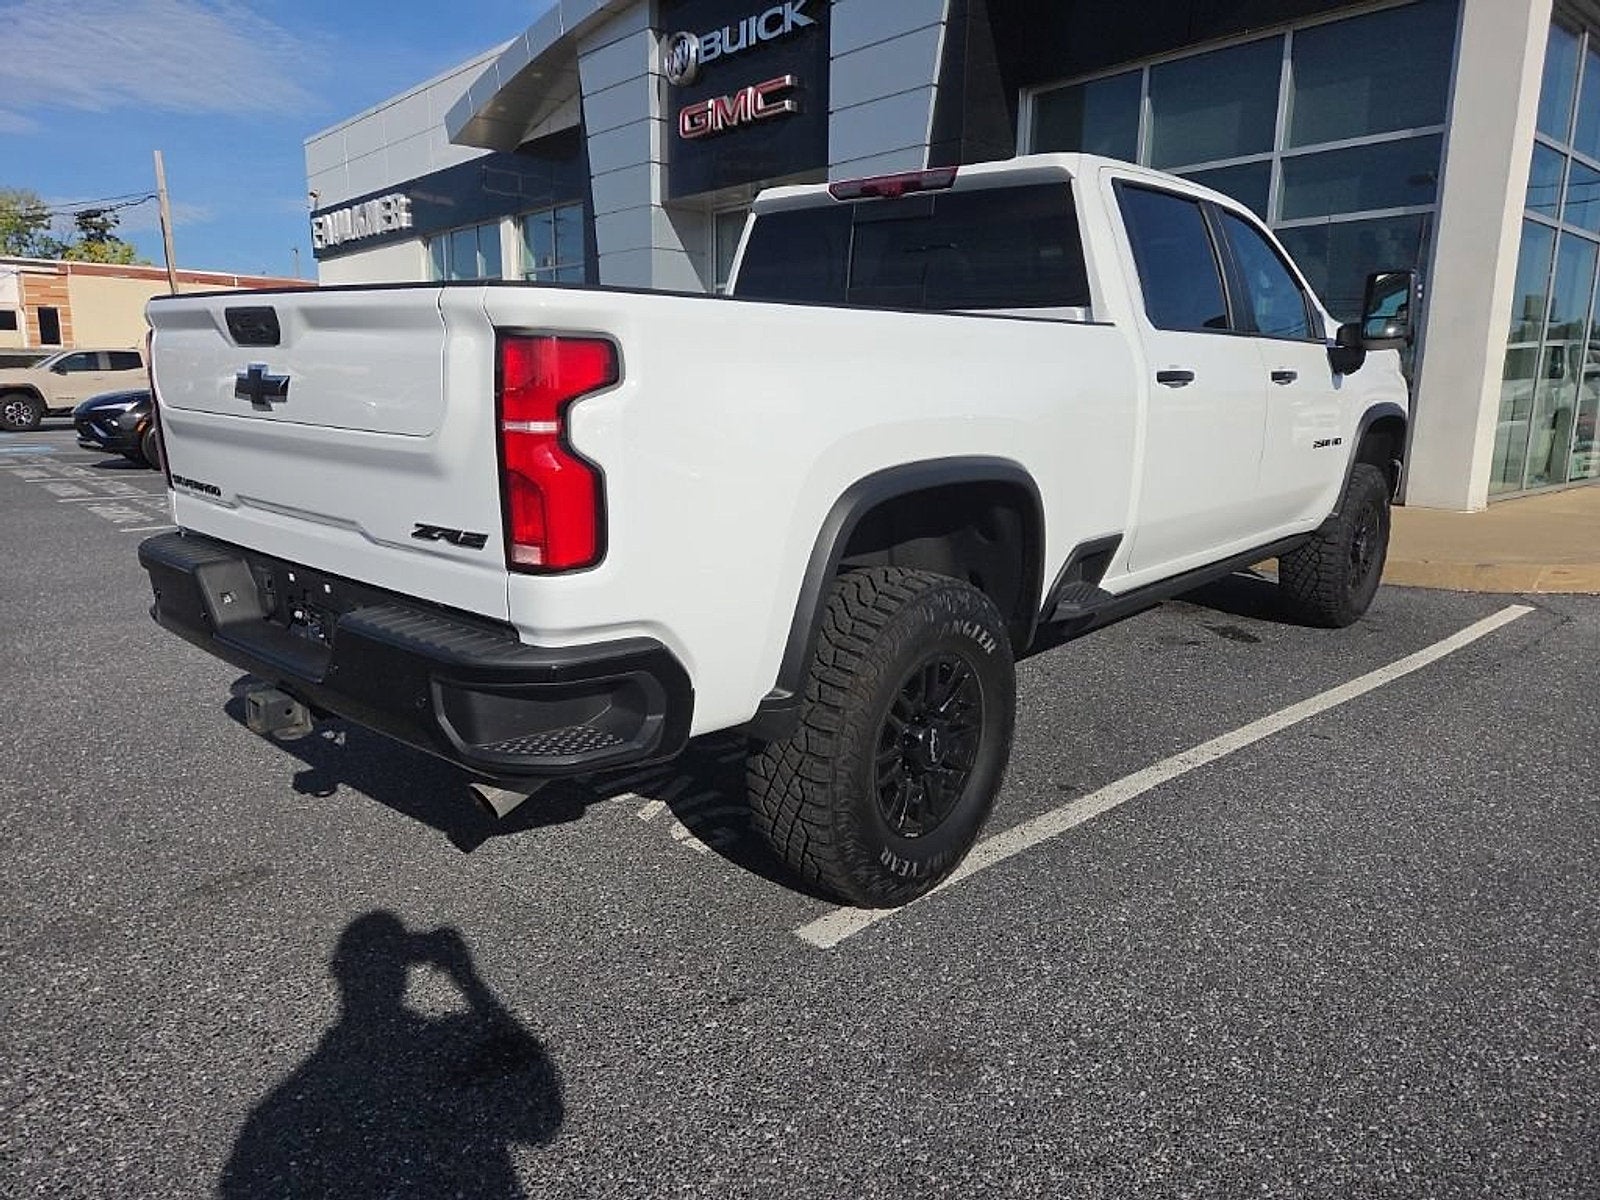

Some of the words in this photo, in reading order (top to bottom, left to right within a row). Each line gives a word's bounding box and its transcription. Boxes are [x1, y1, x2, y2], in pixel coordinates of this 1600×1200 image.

[699, 1, 817, 64] BUICK
[679, 75, 796, 139] GMC
[411, 523, 488, 551] ZR2
